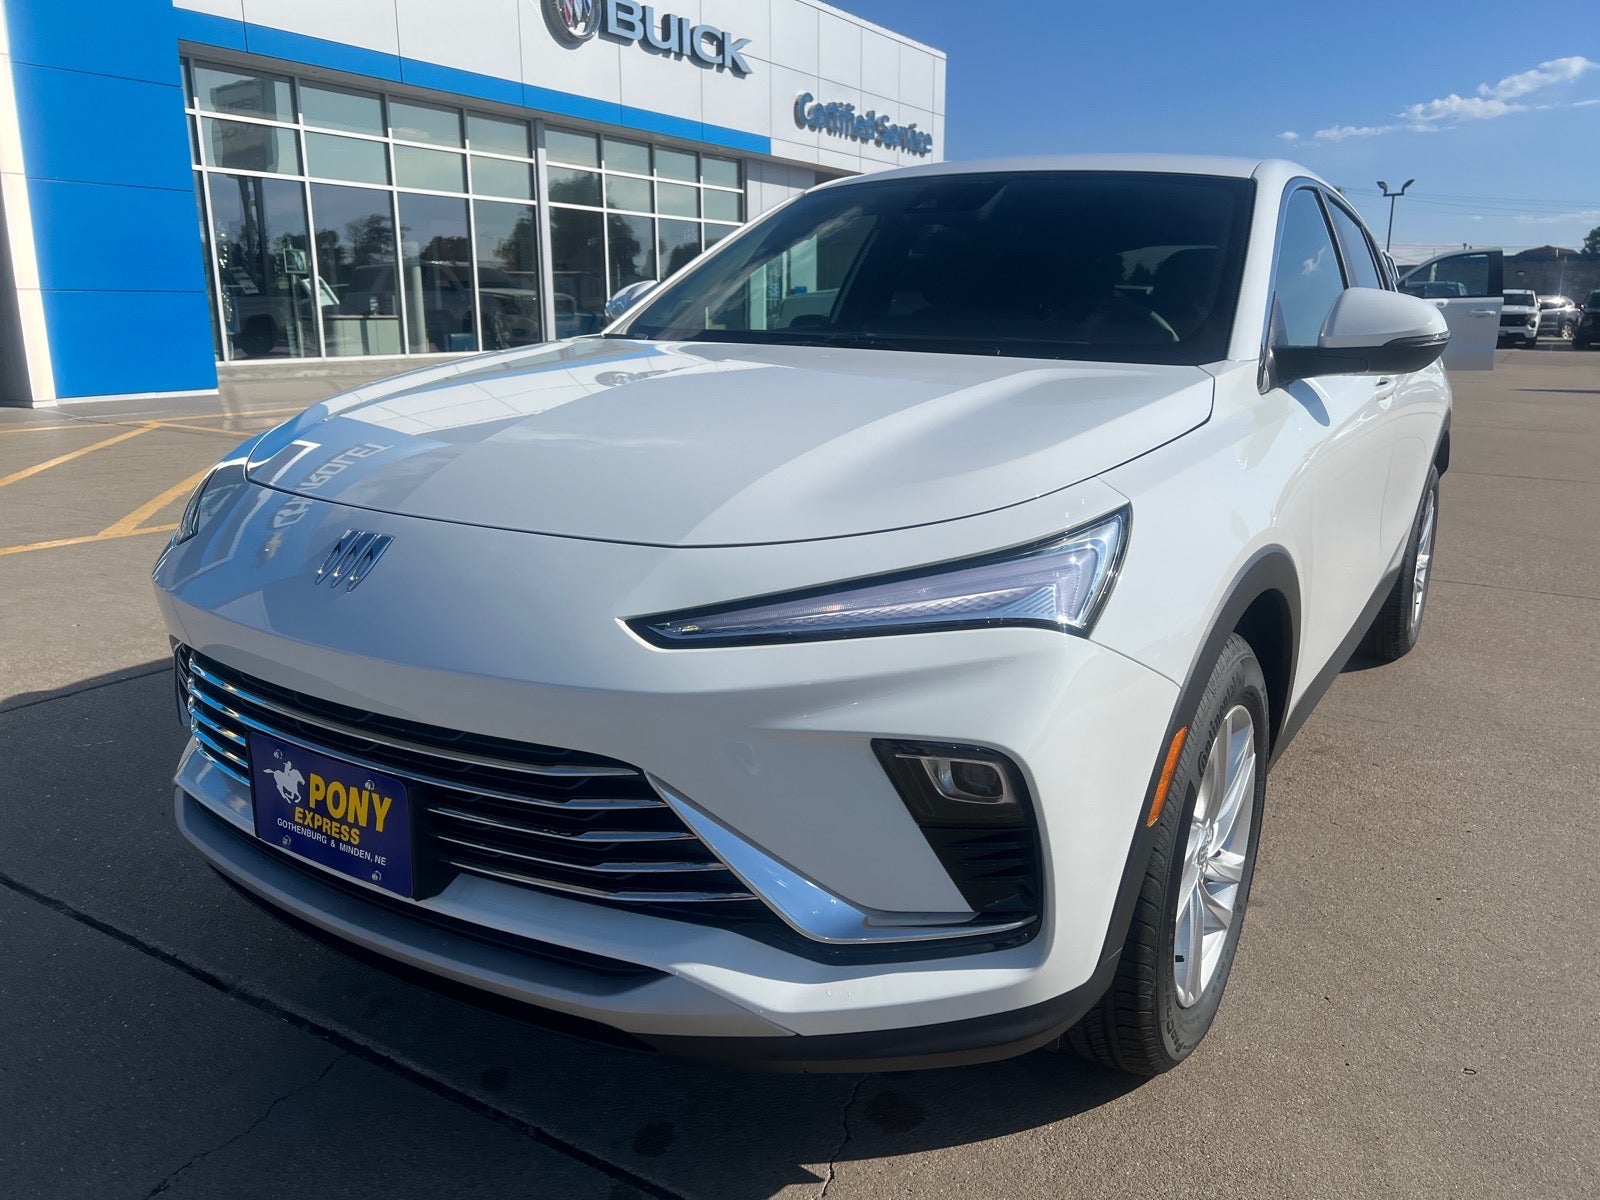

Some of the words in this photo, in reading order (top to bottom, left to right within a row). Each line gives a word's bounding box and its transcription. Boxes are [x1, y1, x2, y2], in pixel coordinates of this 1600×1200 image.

[605, 0, 753, 75] BUICK
[294, 807, 360, 845] EXPRESS
[309, 773, 392, 832] PONY
[277, 818, 328, 844] GOTHENBURG
[330, 839, 336, 848] &
[339, 842, 373, 863] MINDEN,
[374, 856, 387, 866] NE
